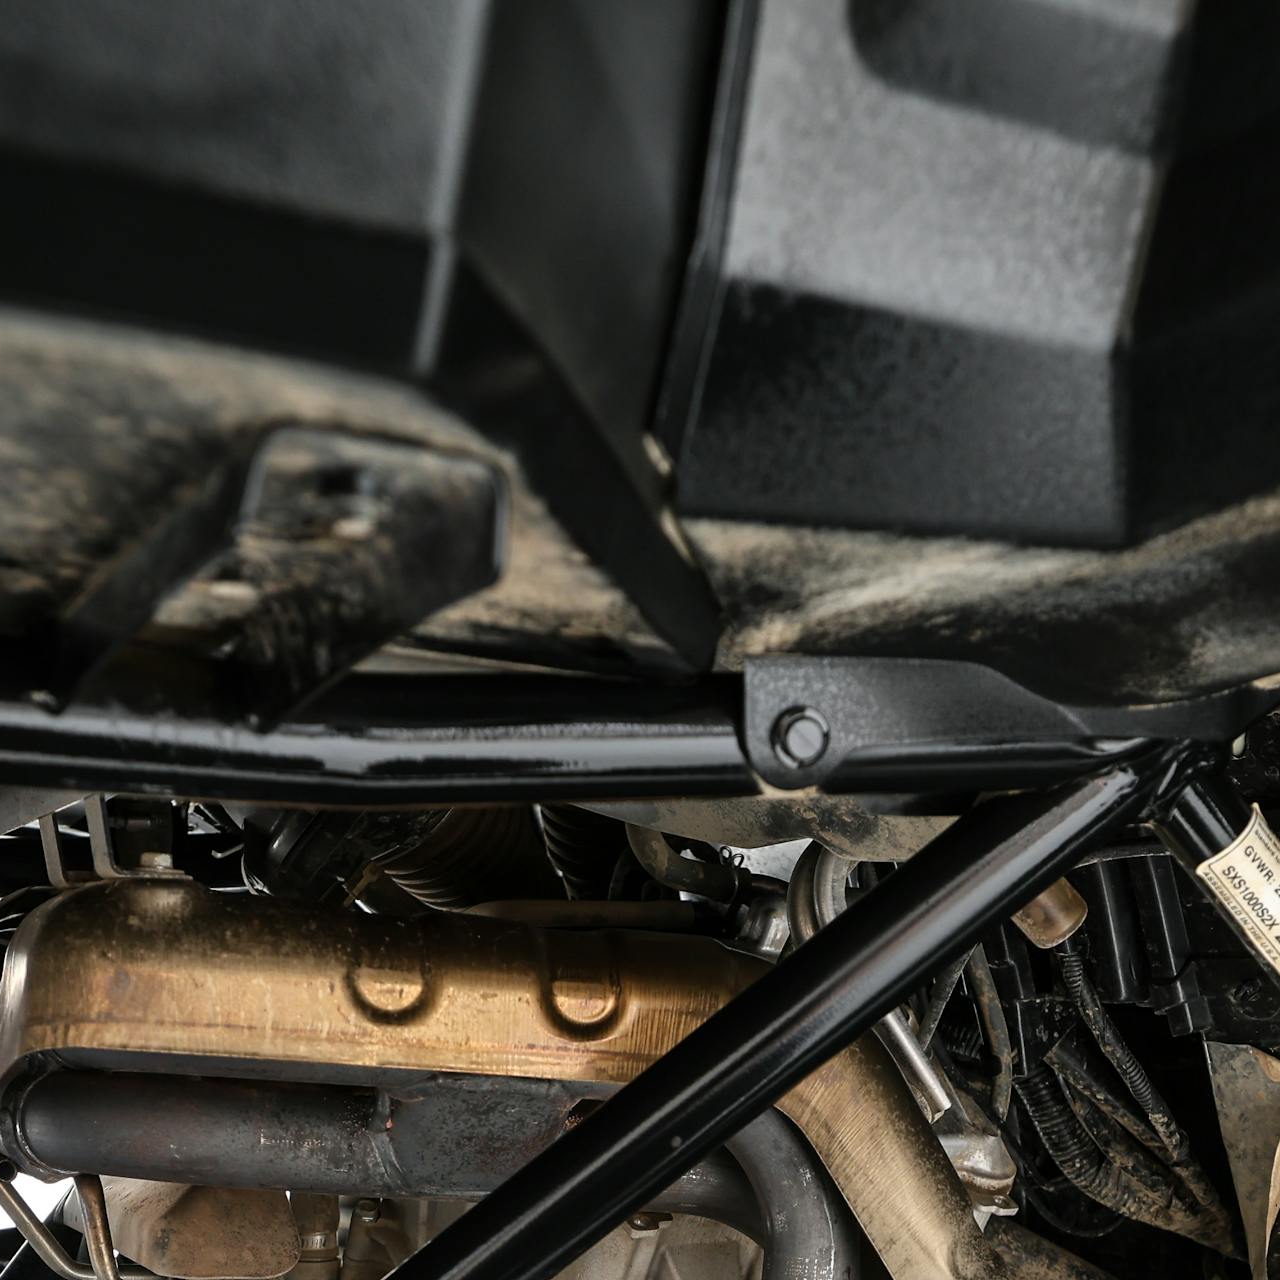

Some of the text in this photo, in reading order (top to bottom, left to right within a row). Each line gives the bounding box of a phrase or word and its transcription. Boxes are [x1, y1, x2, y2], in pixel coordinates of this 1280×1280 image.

[1244, 845, 1277, 885] GVWR:
[1203, 871, 1242, 916] ASSEMBLED
[1222, 865, 1280, 931] SXS1000S2X
